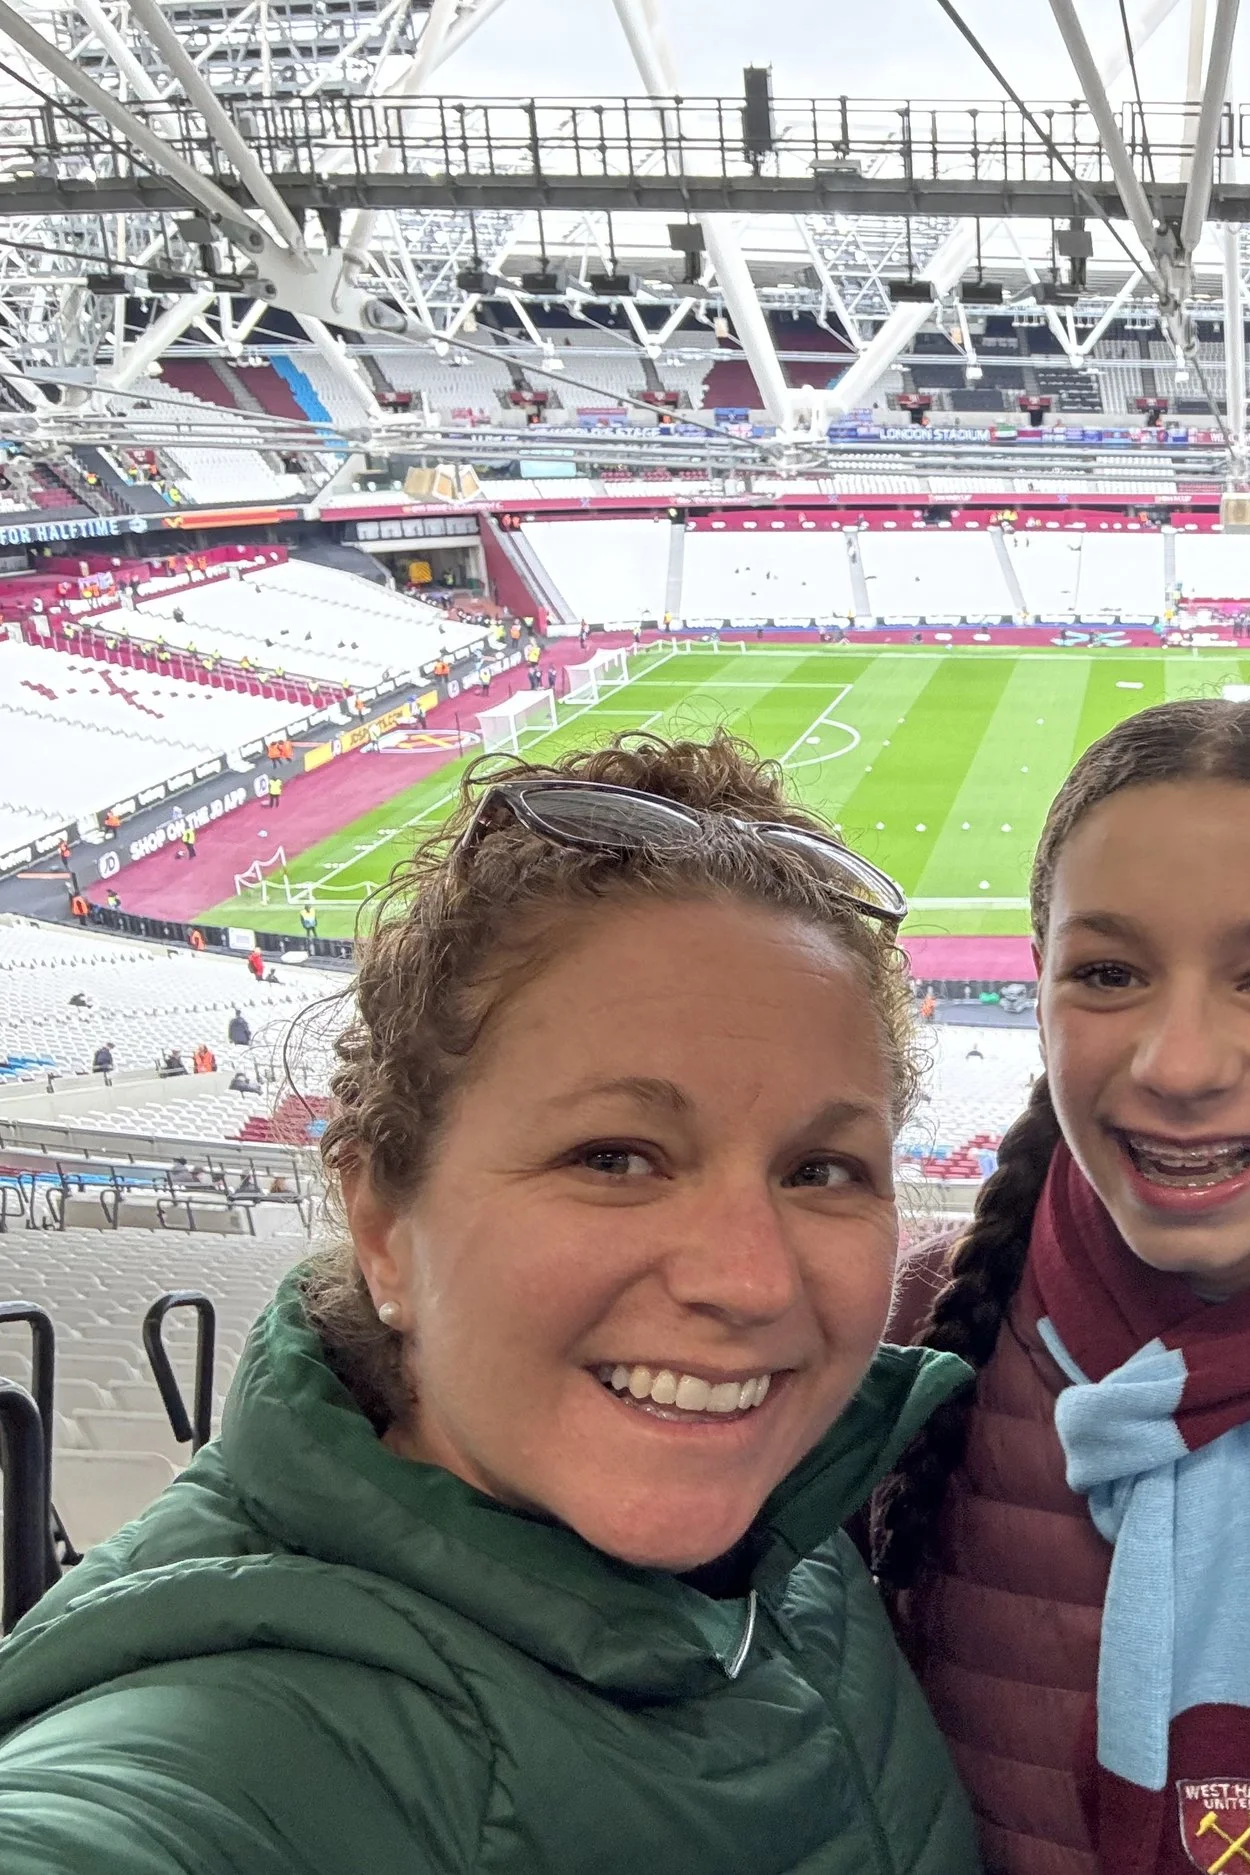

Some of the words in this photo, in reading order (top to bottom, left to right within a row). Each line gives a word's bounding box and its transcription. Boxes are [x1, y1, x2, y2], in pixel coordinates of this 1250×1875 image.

[880, 428, 932, 440] LONDON
[933, 429, 990, 441] STADIUM
[37, 519, 119, 542] HALFTIME
[130, 829, 166, 860] SHOP
[167, 819, 186, 841] ON
[185, 806, 210, 829] THE
[1185, 1783, 1230, 1799] WEST
